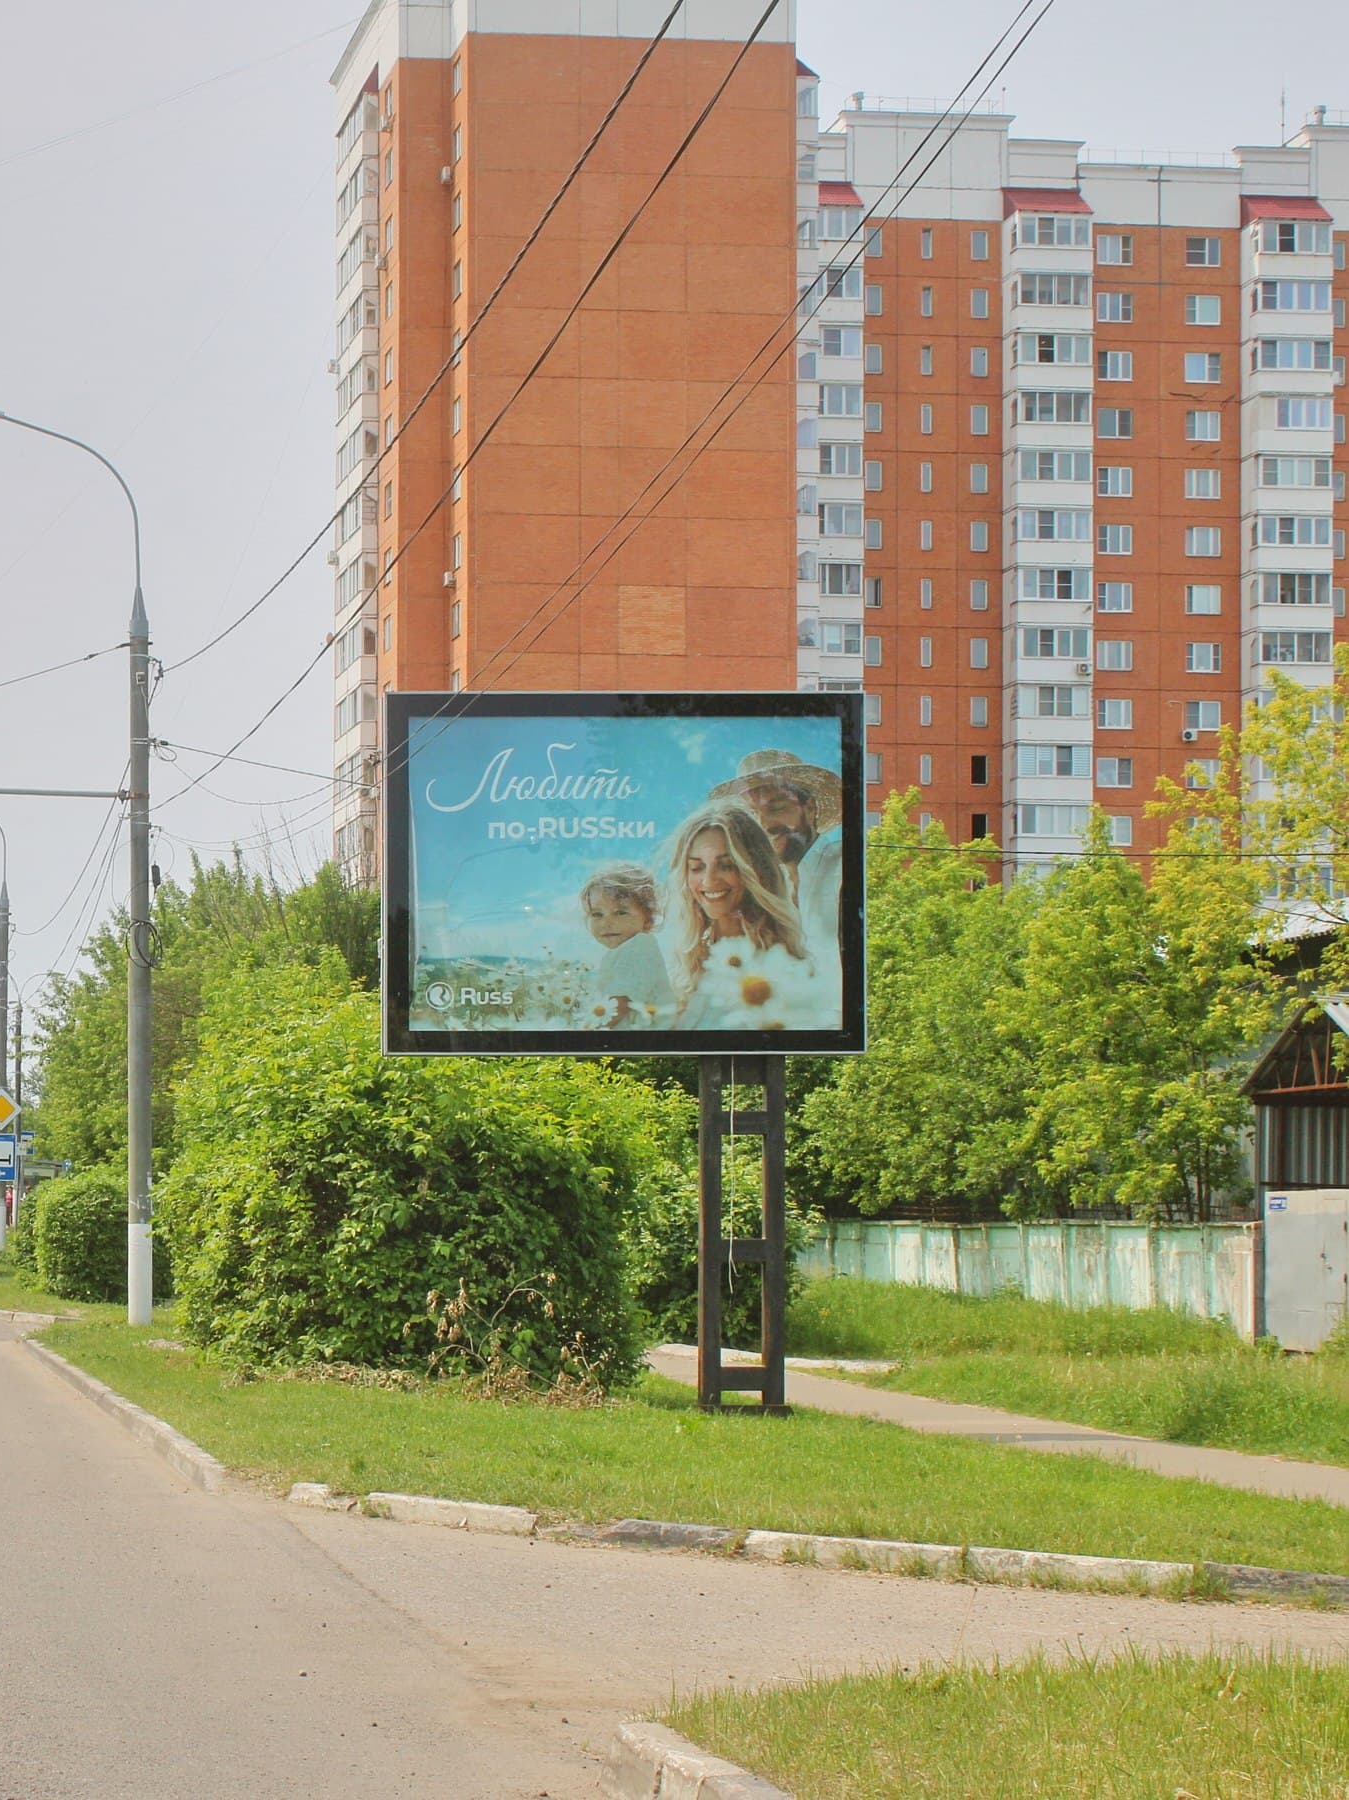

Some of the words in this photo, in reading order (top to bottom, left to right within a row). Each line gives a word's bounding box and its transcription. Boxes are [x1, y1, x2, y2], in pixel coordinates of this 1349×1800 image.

[425, 742, 641, 813] Любить
[487, 817, 655, 840] по-RUSSки
[460, 987, 514, 1005] Russ
